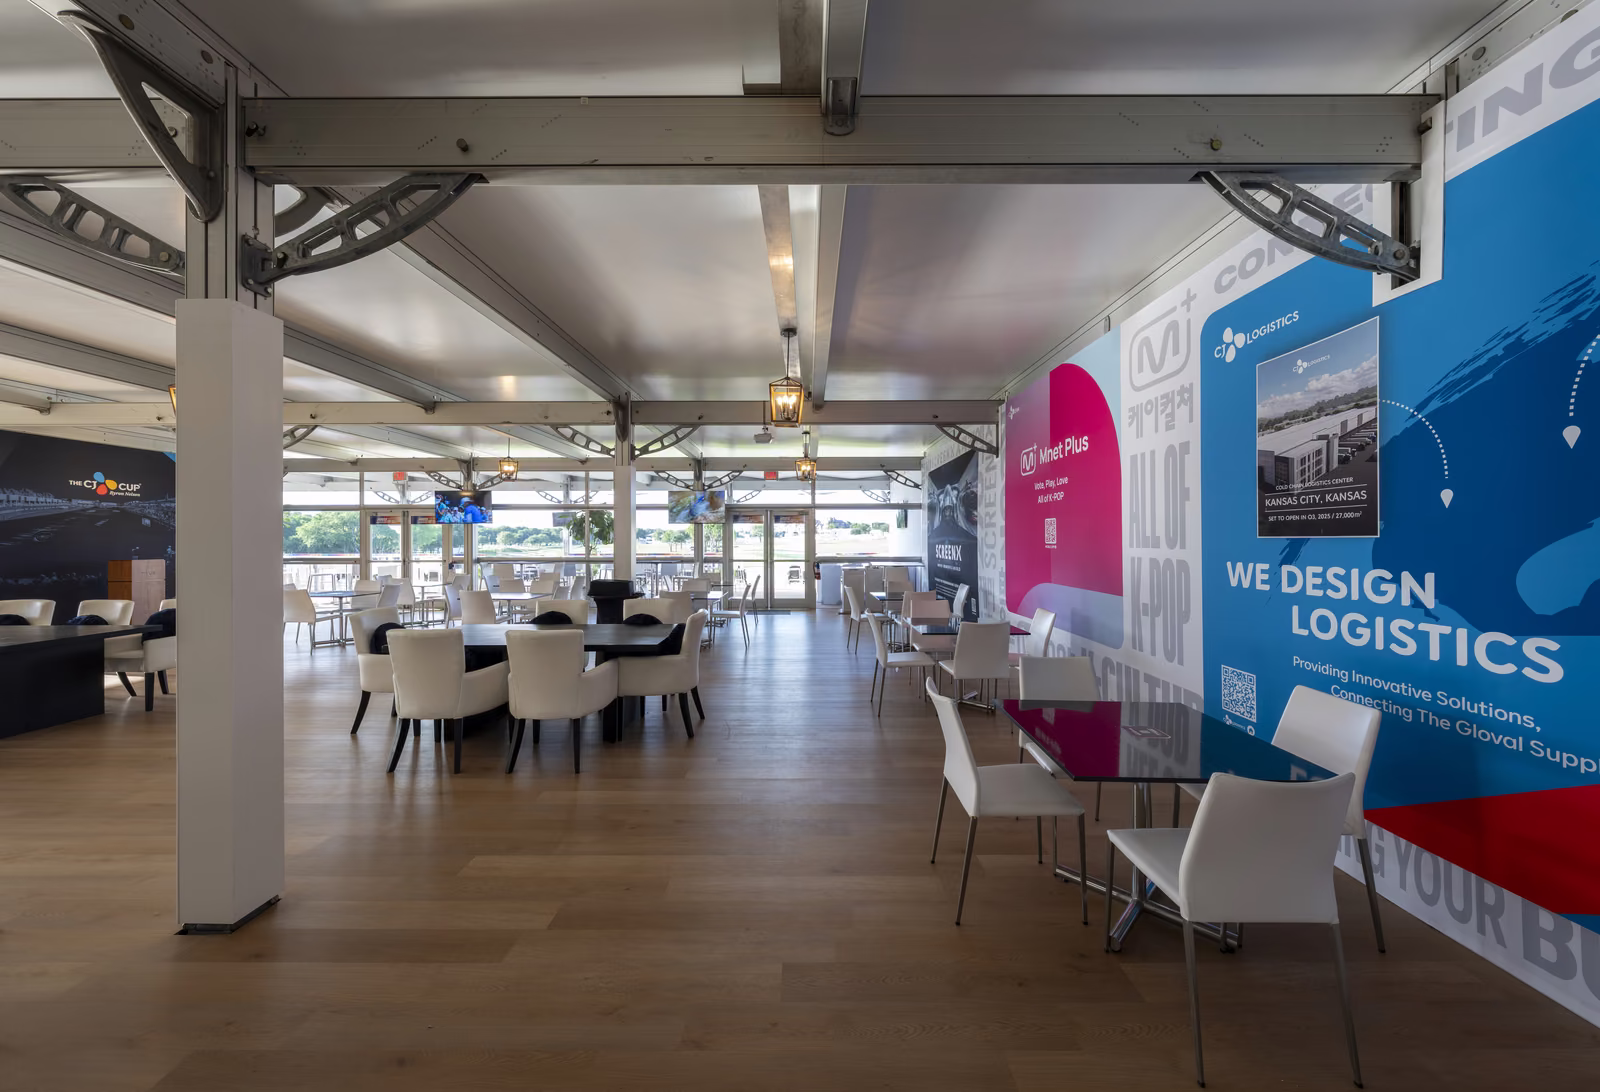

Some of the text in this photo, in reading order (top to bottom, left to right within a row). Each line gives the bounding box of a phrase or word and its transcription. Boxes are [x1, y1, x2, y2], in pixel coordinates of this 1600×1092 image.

[1214, 310, 1299, 358] CJ LOGISTICS
[1039, 436, 1089, 464] Mnet Plus
[83, 480, 98, 490] CJ
[1057, 477, 1069, 486] Love
[1129, 447, 1160, 549] ALL
[1164, 440, 1191, 550] OF
[1265, 490, 1367, 507] KANSAS CITY, KANSAS
[1332, 477, 1354, 485] CENTER
[936, 544, 962, 561] SCREENX
[1226, 561, 1435, 609] WE DESIGN
[1130, 557, 1190, 667] K-POP
[1292, 605, 1565, 684] LOGISTICS
[1293, 655, 1541, 733] Providing Innovative Solutions,
[1331, 685, 1413, 722] Connecting
[1416, 708, 1451, 730] The
[1455, 720, 1523, 752] Gloval
[1393, 834, 1508, 949] YOUR
